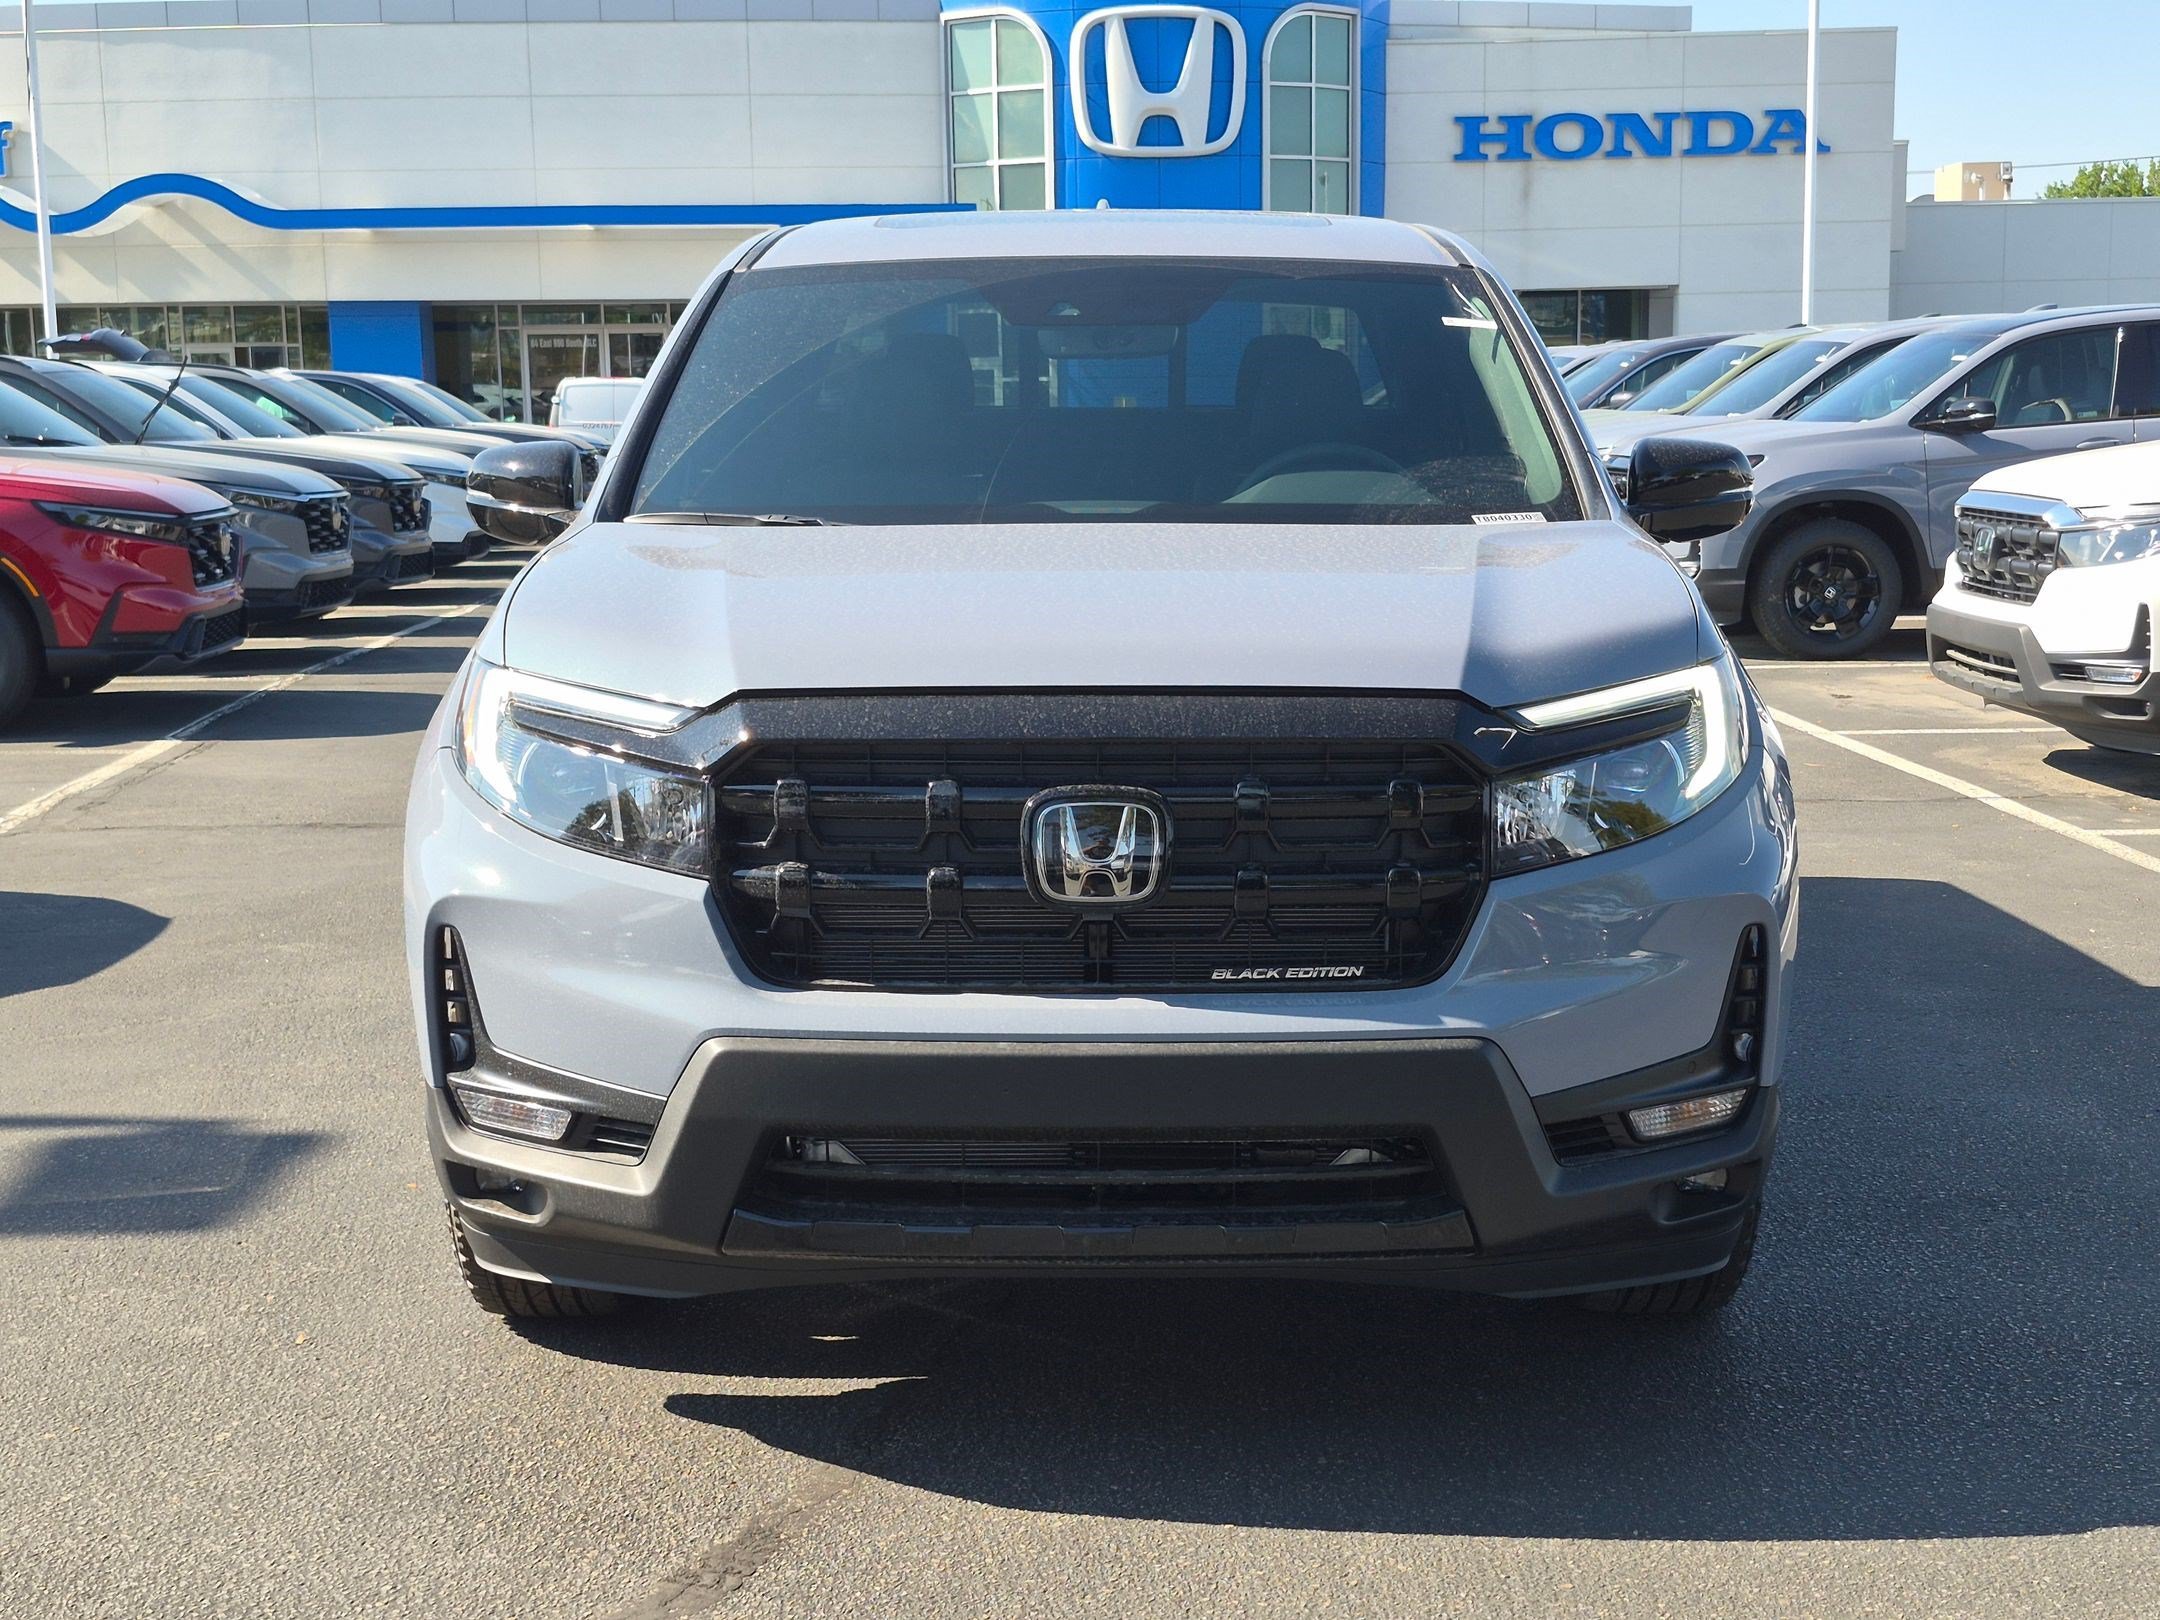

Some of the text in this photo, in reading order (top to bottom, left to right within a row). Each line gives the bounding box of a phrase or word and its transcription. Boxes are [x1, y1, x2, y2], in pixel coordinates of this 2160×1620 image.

[1453, 108, 1832, 162] HONDA
[1211, 966, 1364, 980] BLACK EDITION
